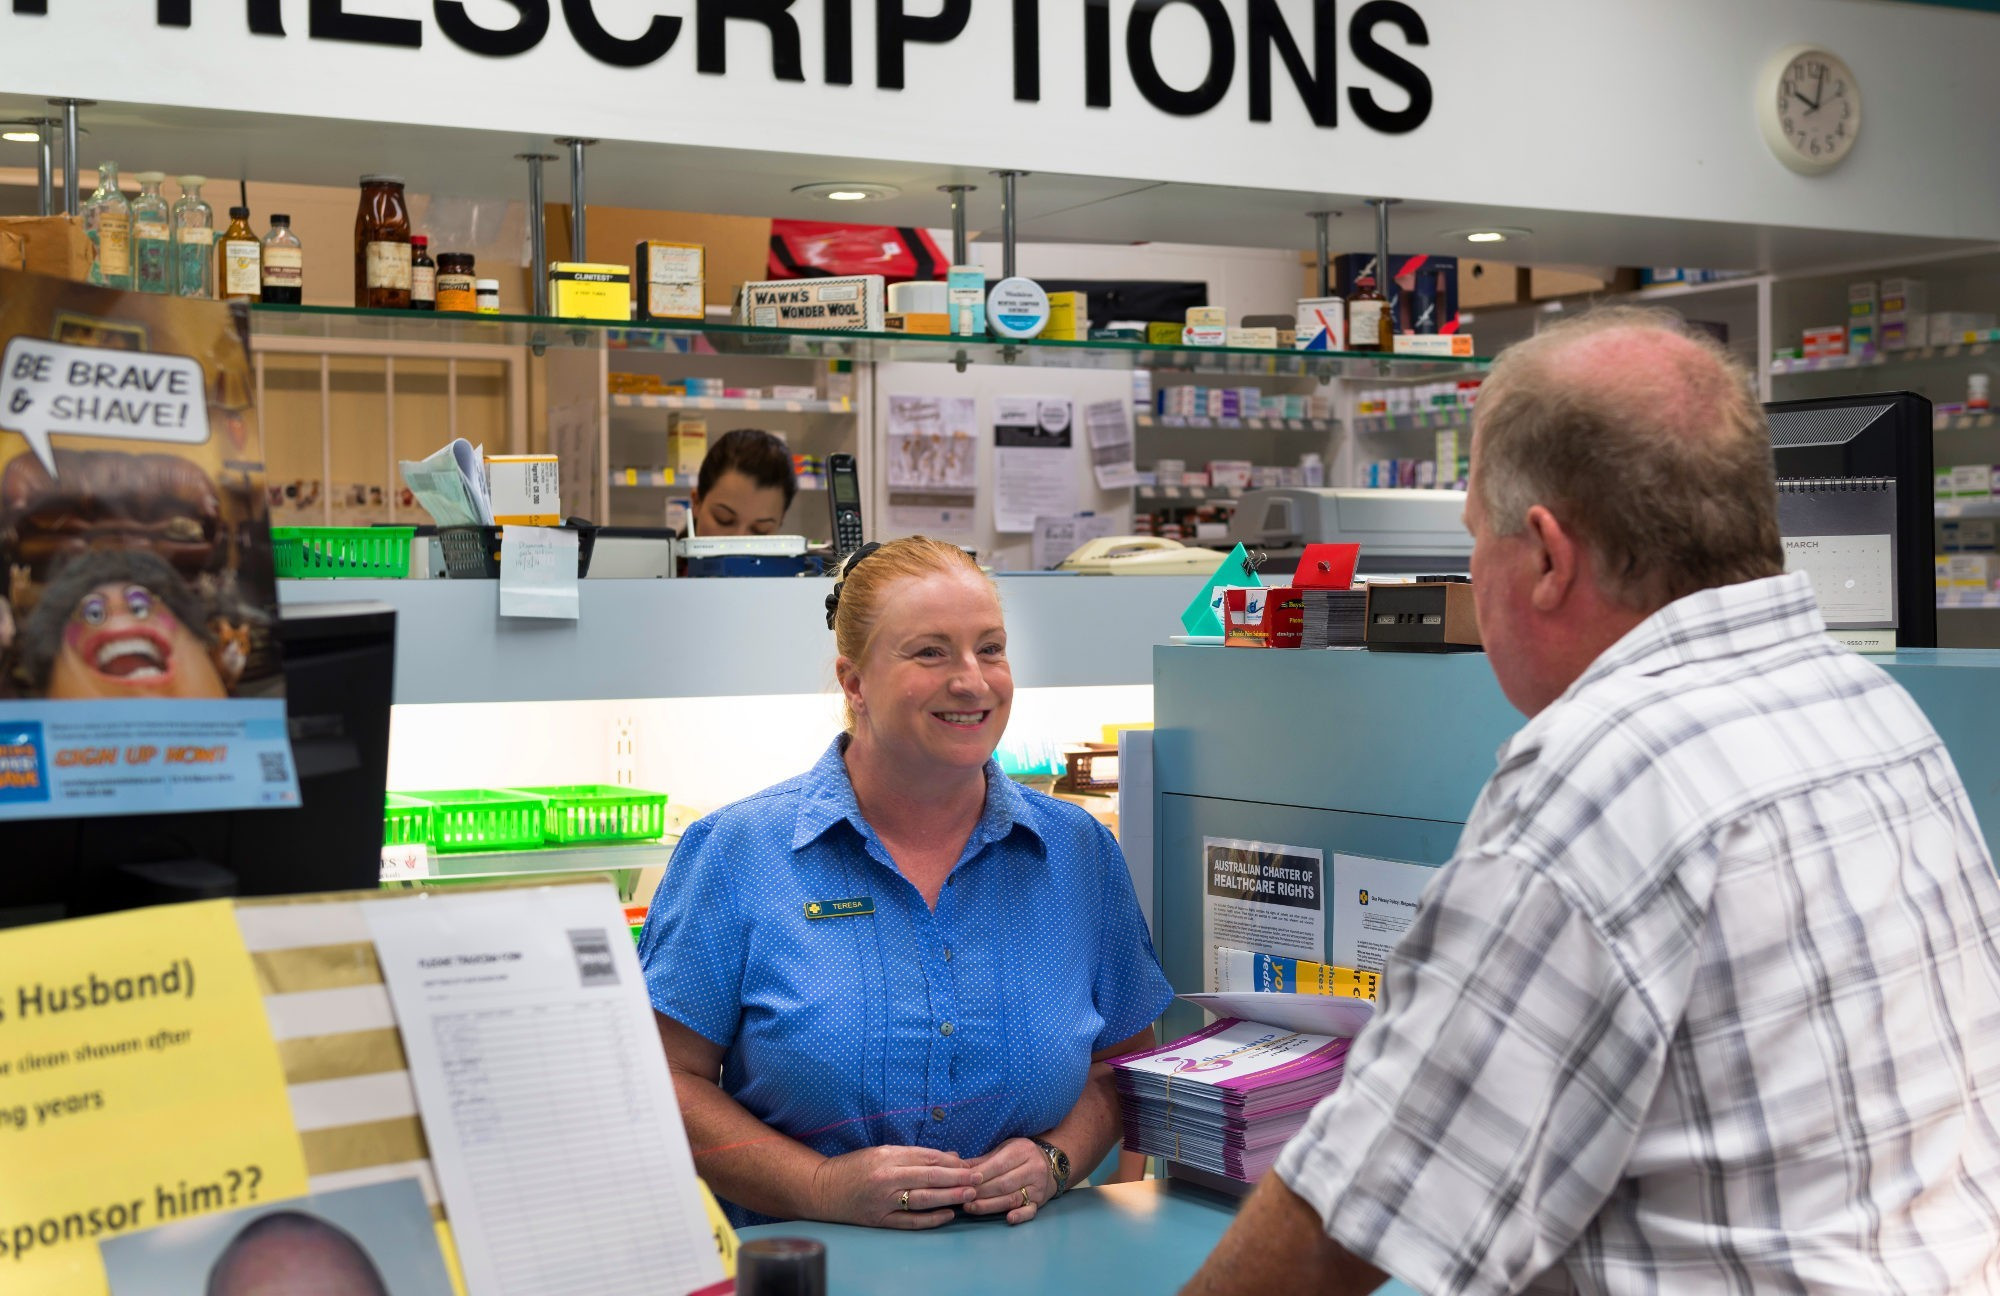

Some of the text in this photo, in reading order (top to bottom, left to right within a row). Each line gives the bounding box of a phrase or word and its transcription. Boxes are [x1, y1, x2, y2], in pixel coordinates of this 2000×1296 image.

[781, 305, 825, 319] WONDER
[827, 303, 859, 316] WOOL
[12, 353, 191, 395] BE BRAVE
[9, 388, 189, 428] & SHAVE!
[54, 747, 119, 768] SIGN
[124, 745, 160, 765] UP
[164, 744, 229, 764] NOW!
[1214, 859, 1313, 882] AUSTRALIAN CHARTER OF
[1214, 874, 1315, 899] HEALTHCARE RIGHTS
[832, 902, 863, 910] TERESA
[19, 958, 197, 1018] Husband)
[19, 1051, 71, 1074] clean
[76, 1037, 142, 1063] shaven
[146, 1029, 192, 1051] after
[34, 1090, 104, 1125] years
[156, 1164, 263, 1220] him??
